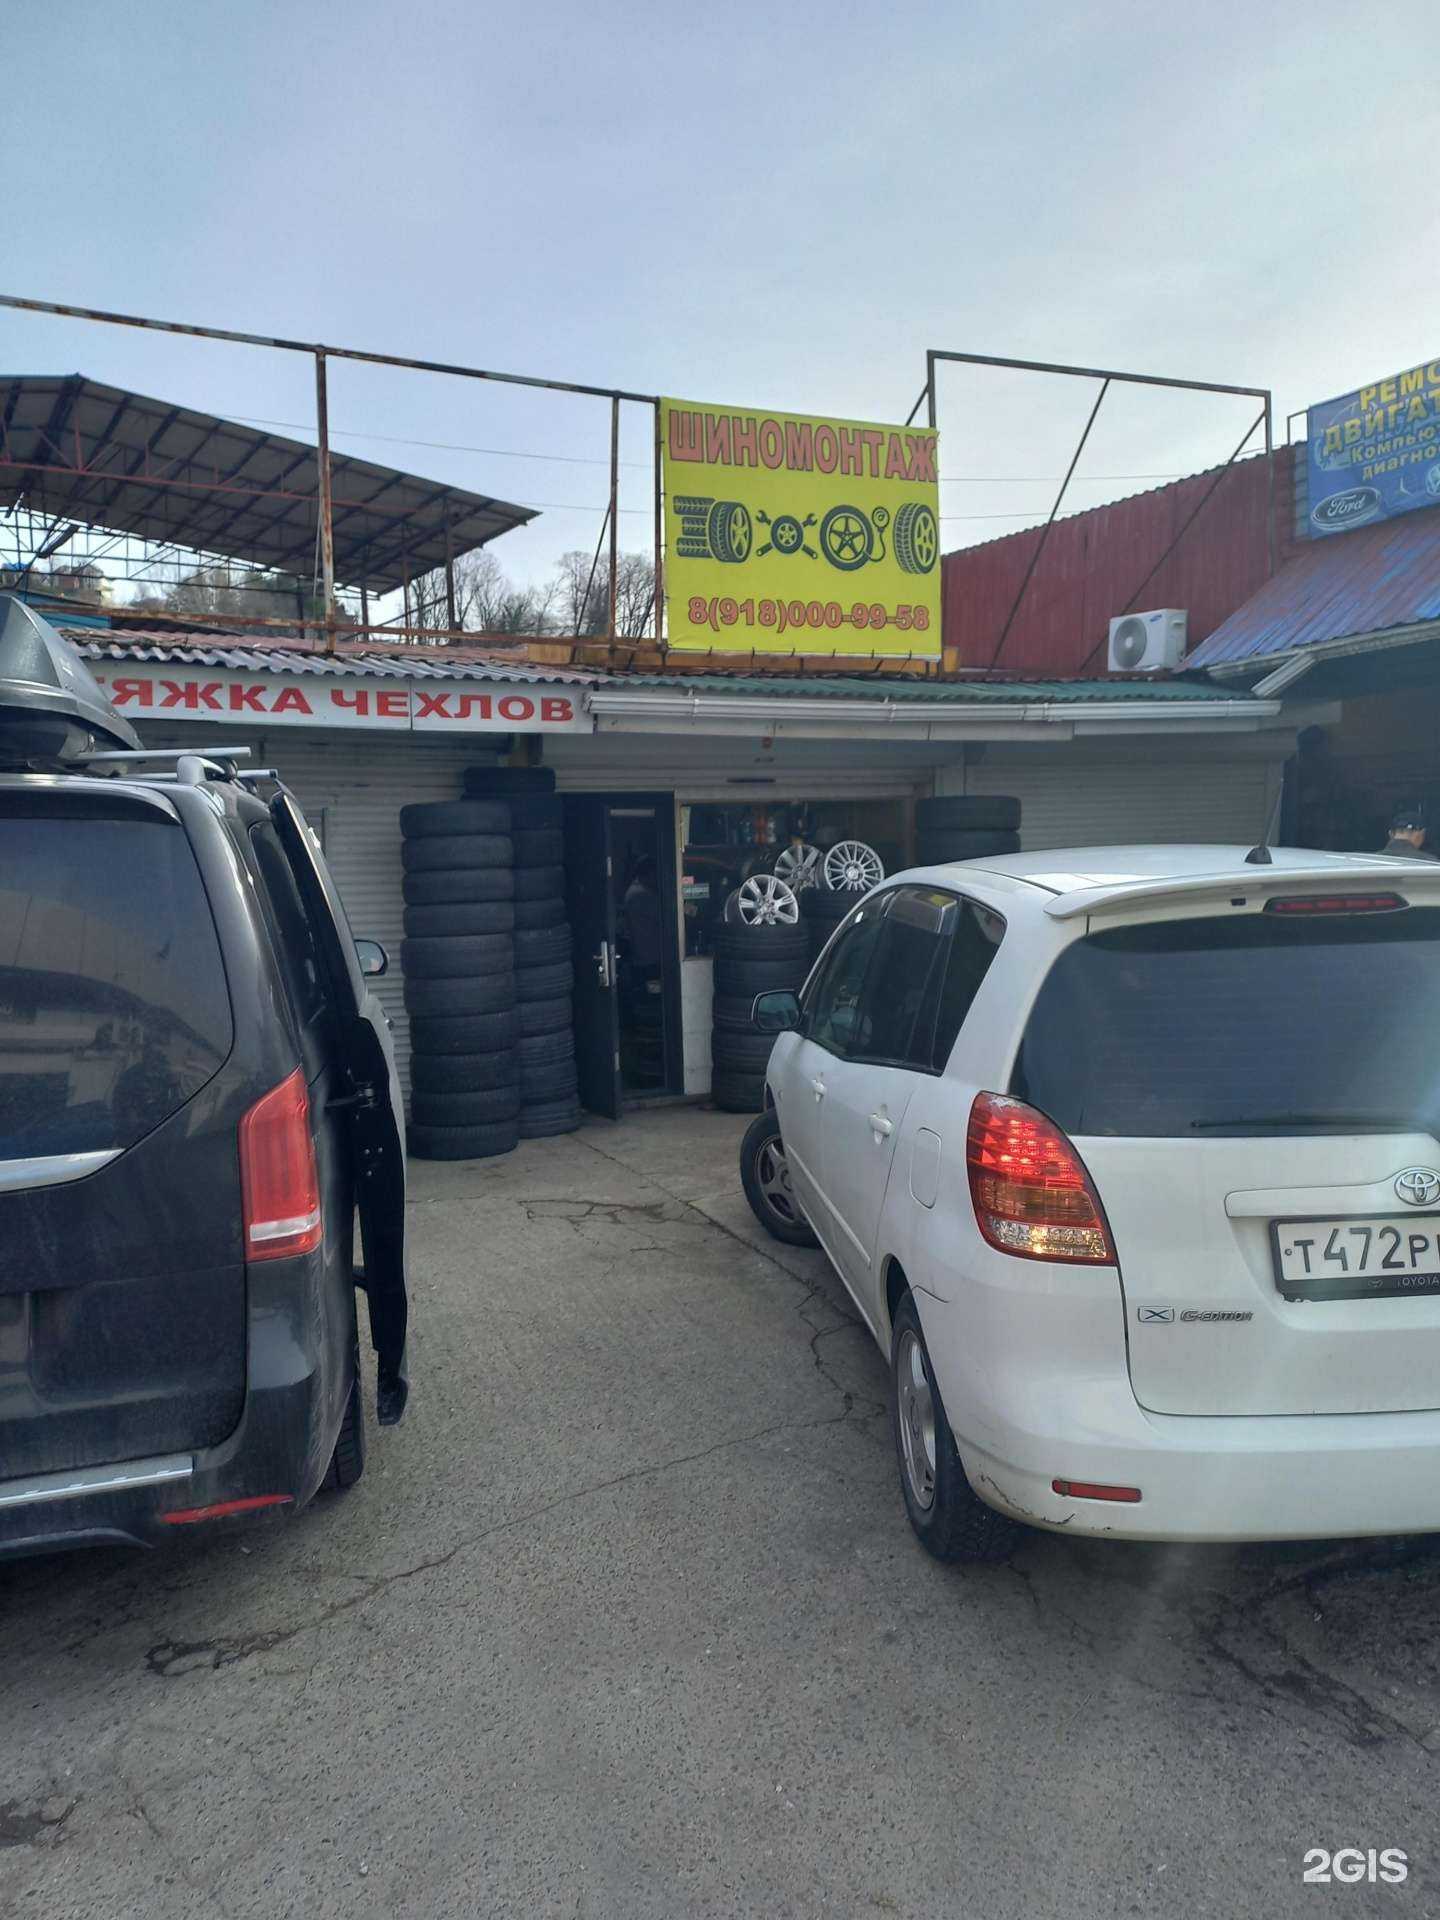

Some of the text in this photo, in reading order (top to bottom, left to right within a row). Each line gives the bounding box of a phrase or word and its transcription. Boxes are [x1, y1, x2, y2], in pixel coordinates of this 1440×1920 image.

[669, 409, 938, 482] ШИНОМОНТАЖ
[1352, 422, 1440, 464] Компью
[1362, 444, 1440, 480] диагно
[1327, 495, 1366, 517] Ford
[688, 596, 930, 633] 8(918)000-99-58
[96, 676, 574, 721] ЯЖКА ЧЕХЛОВ
[1294, 1226, 1440, 1273] Т472Р
